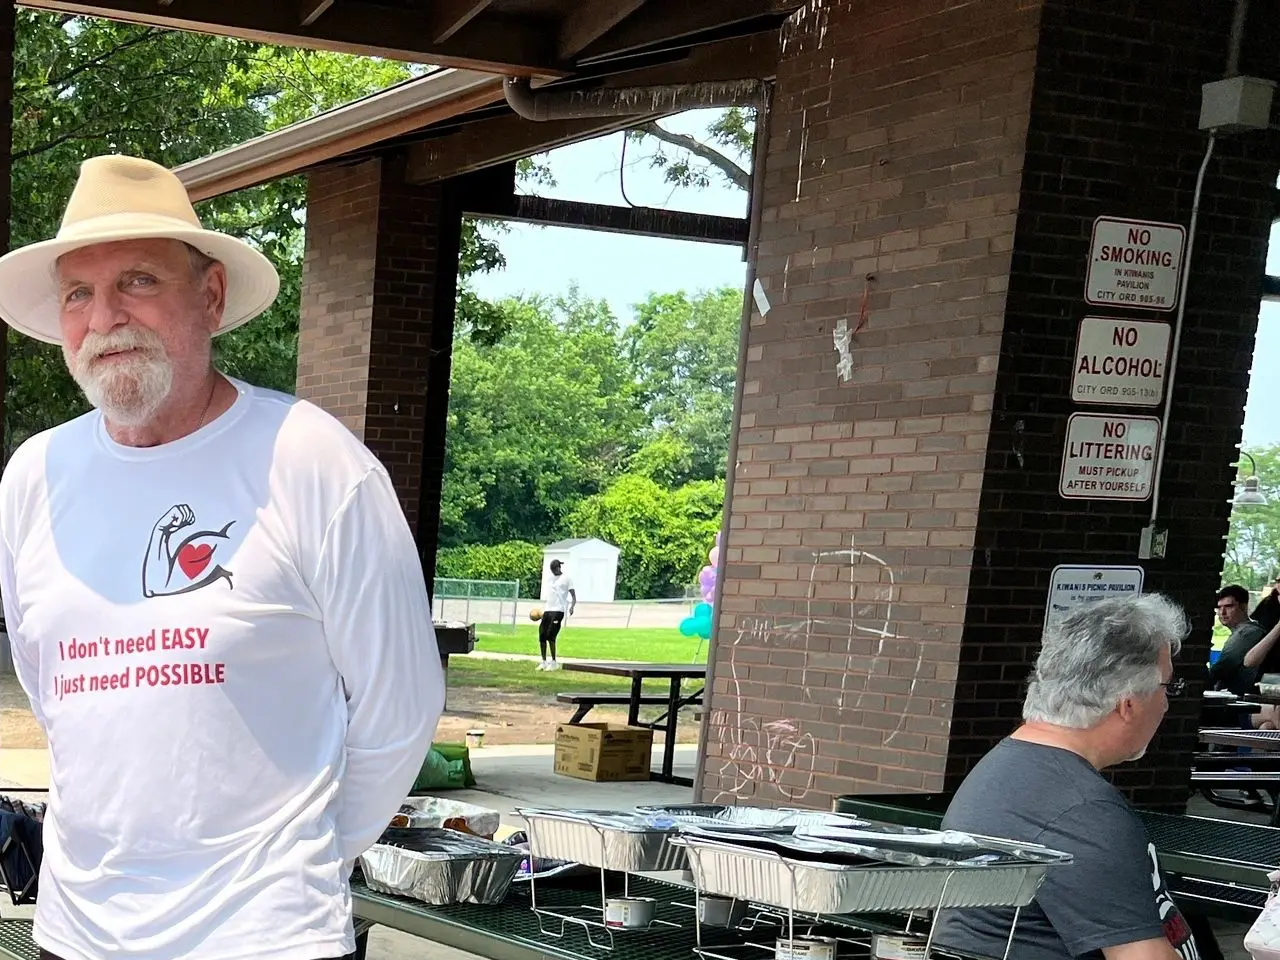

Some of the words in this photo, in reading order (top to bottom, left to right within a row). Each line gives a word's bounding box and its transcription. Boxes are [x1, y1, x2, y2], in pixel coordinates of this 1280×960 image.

[1127, 228, 1151, 246] NO
[1100, 245, 1172, 267] SMOKING
[1114, 268, 1122, 277] IN
[1117, 280, 1150, 290] PAVILION
[1097, 291, 1116, 300] CITY
[1119, 293, 1137, 302] ORD
[1112, 326, 1138, 347] NO
[1078, 355, 1162, 378] ALCOHOL
[1077, 385, 1097, 394] CITY
[1100, 386, 1118, 395] ORD
[1103, 421, 1126, 438] NO
[1069, 442, 1152, 461] LITTERING
[1079, 466, 1103, 476] MUST
[1106, 467, 1139, 477] PICKUP
[1067, 480, 1097, 490] AFTER
[1099, 481, 1146, 492] YOURSELF
[59, 641, 65, 661] I
[68, 636, 110, 660] don't
[115, 629, 156, 654] need
[161, 627, 210, 650] EASY
[54, 676, 58, 696] I
[59, 674, 85, 701] just
[89, 667, 130, 692] need
[135, 663, 225, 687] POSSIBLE
